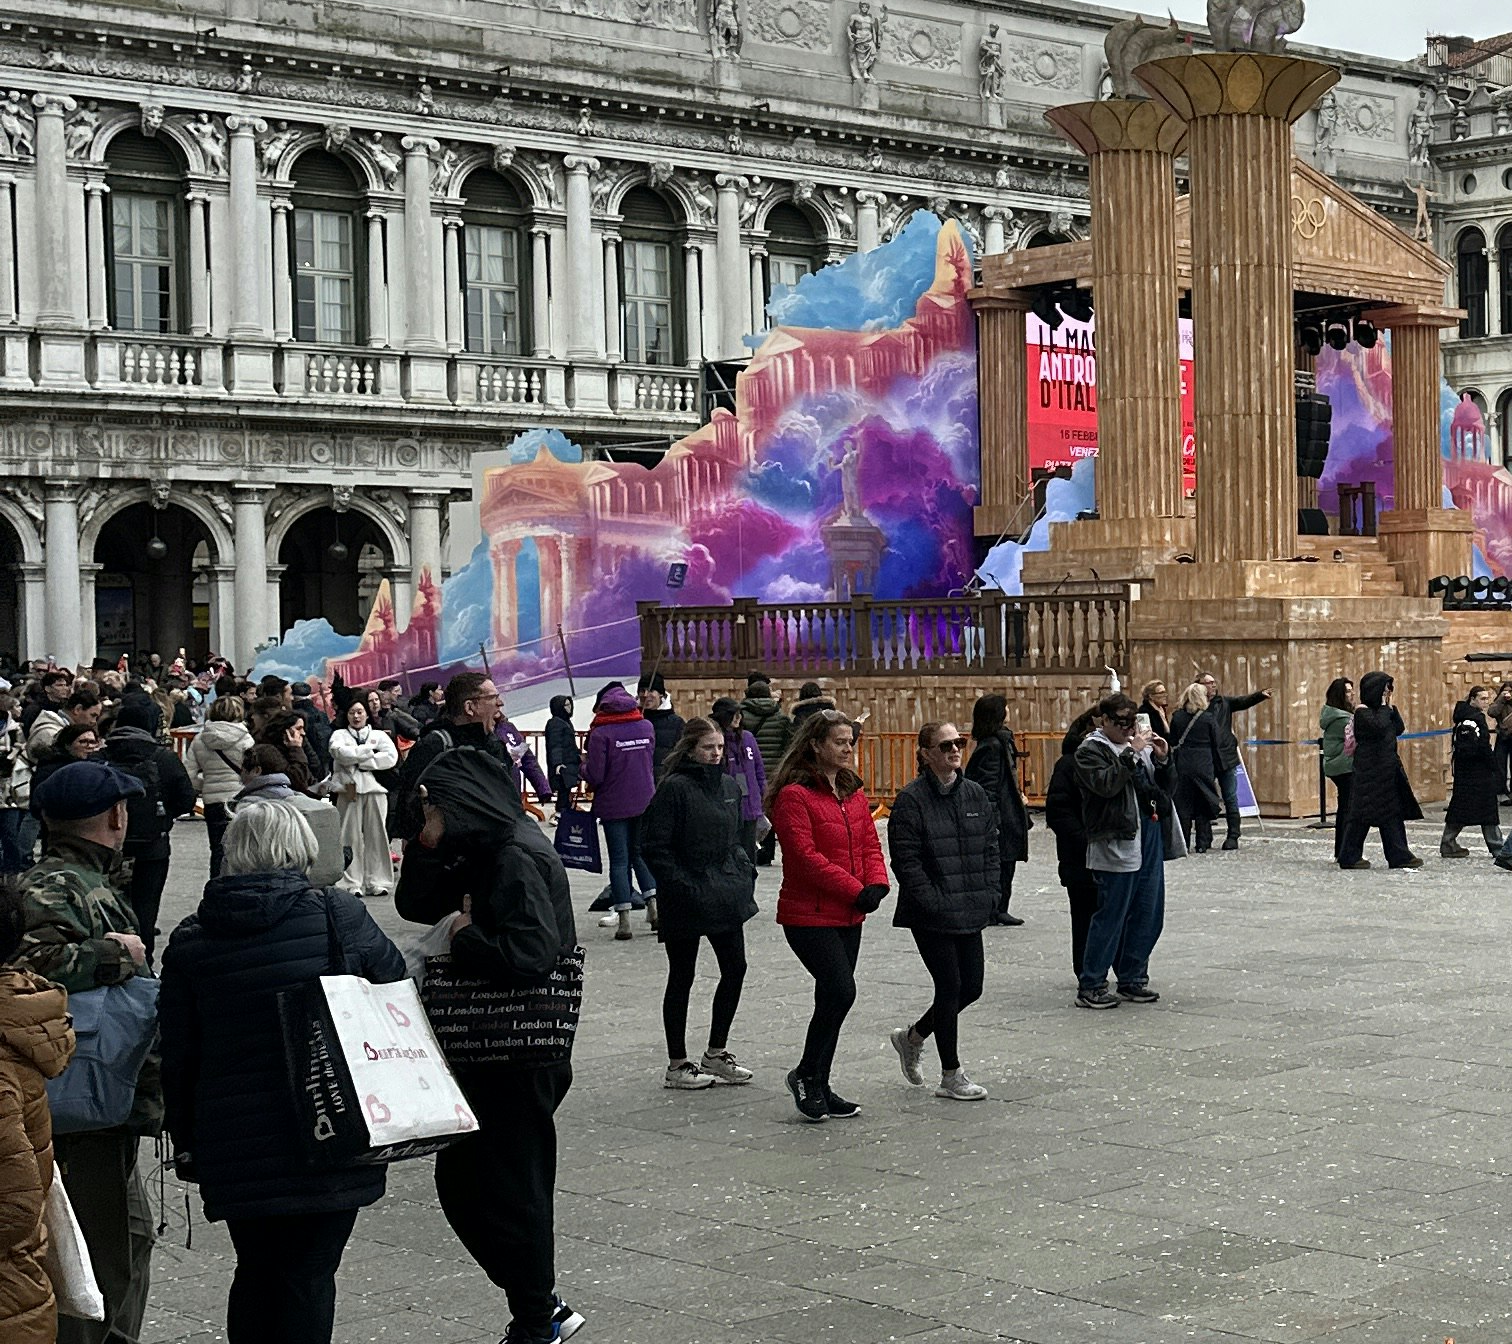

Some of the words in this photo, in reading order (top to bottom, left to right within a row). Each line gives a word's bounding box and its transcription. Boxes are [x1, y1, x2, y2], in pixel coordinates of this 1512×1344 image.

[1039, 351, 1096, 387] ANTRO
[1040, 379, 1096, 412] D'ITAL
[1060, 429, 1070, 440] 16
[447, 1004, 484, 1015] London
[513, 1018, 552, 1030] London
[443, 1039, 481, 1050] London
[484, 1036, 524, 1047] London
[527, 1035, 565, 1046] London
[322, 1060, 335, 1077] the
[326, 1079, 346, 1114] LOVE
